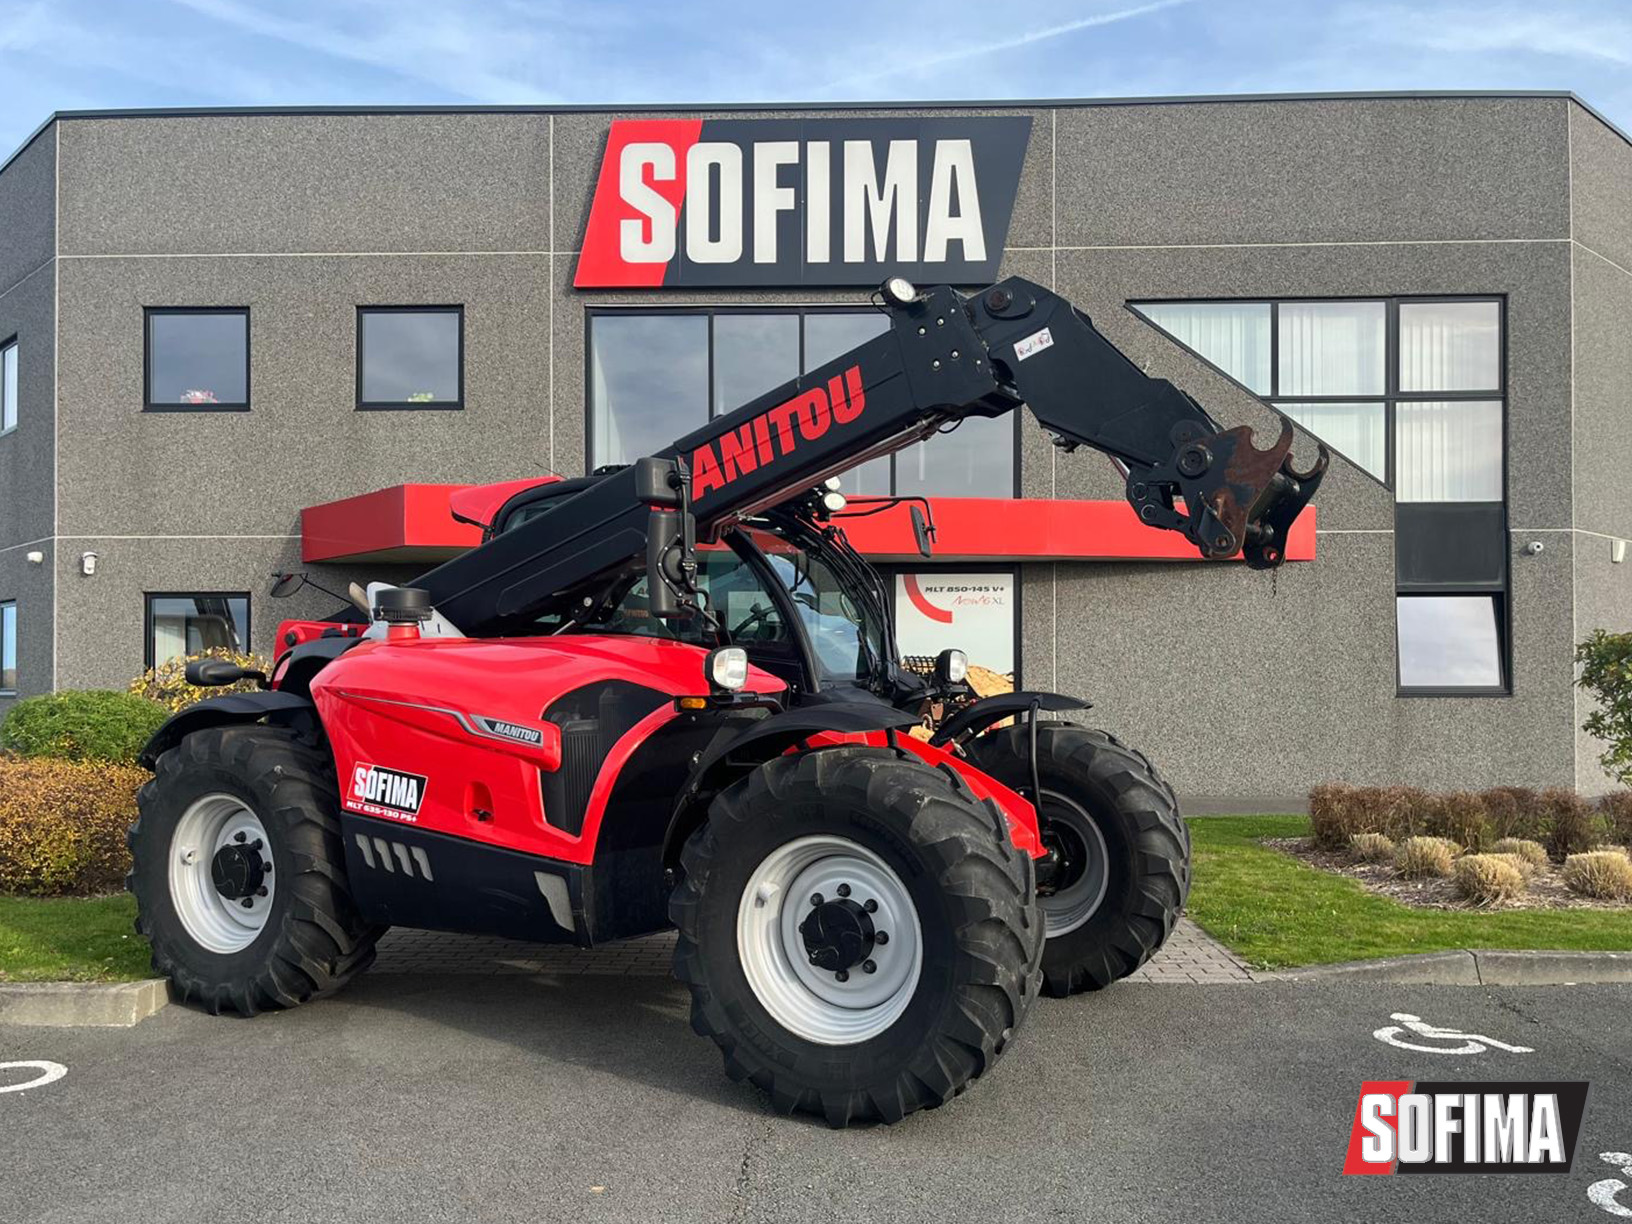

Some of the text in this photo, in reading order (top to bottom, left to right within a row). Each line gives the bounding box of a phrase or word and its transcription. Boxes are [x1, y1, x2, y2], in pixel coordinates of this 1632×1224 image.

[619, 139, 987, 264] SOFIMA
[650, 365, 866, 512] ANITOU
[992, 596, 1005, 606] XL
[493, 722, 540, 741] MANITOU
[354, 767, 418, 811] SOFIMA
[346, 801, 418, 823] MLT 635-130 PS+
